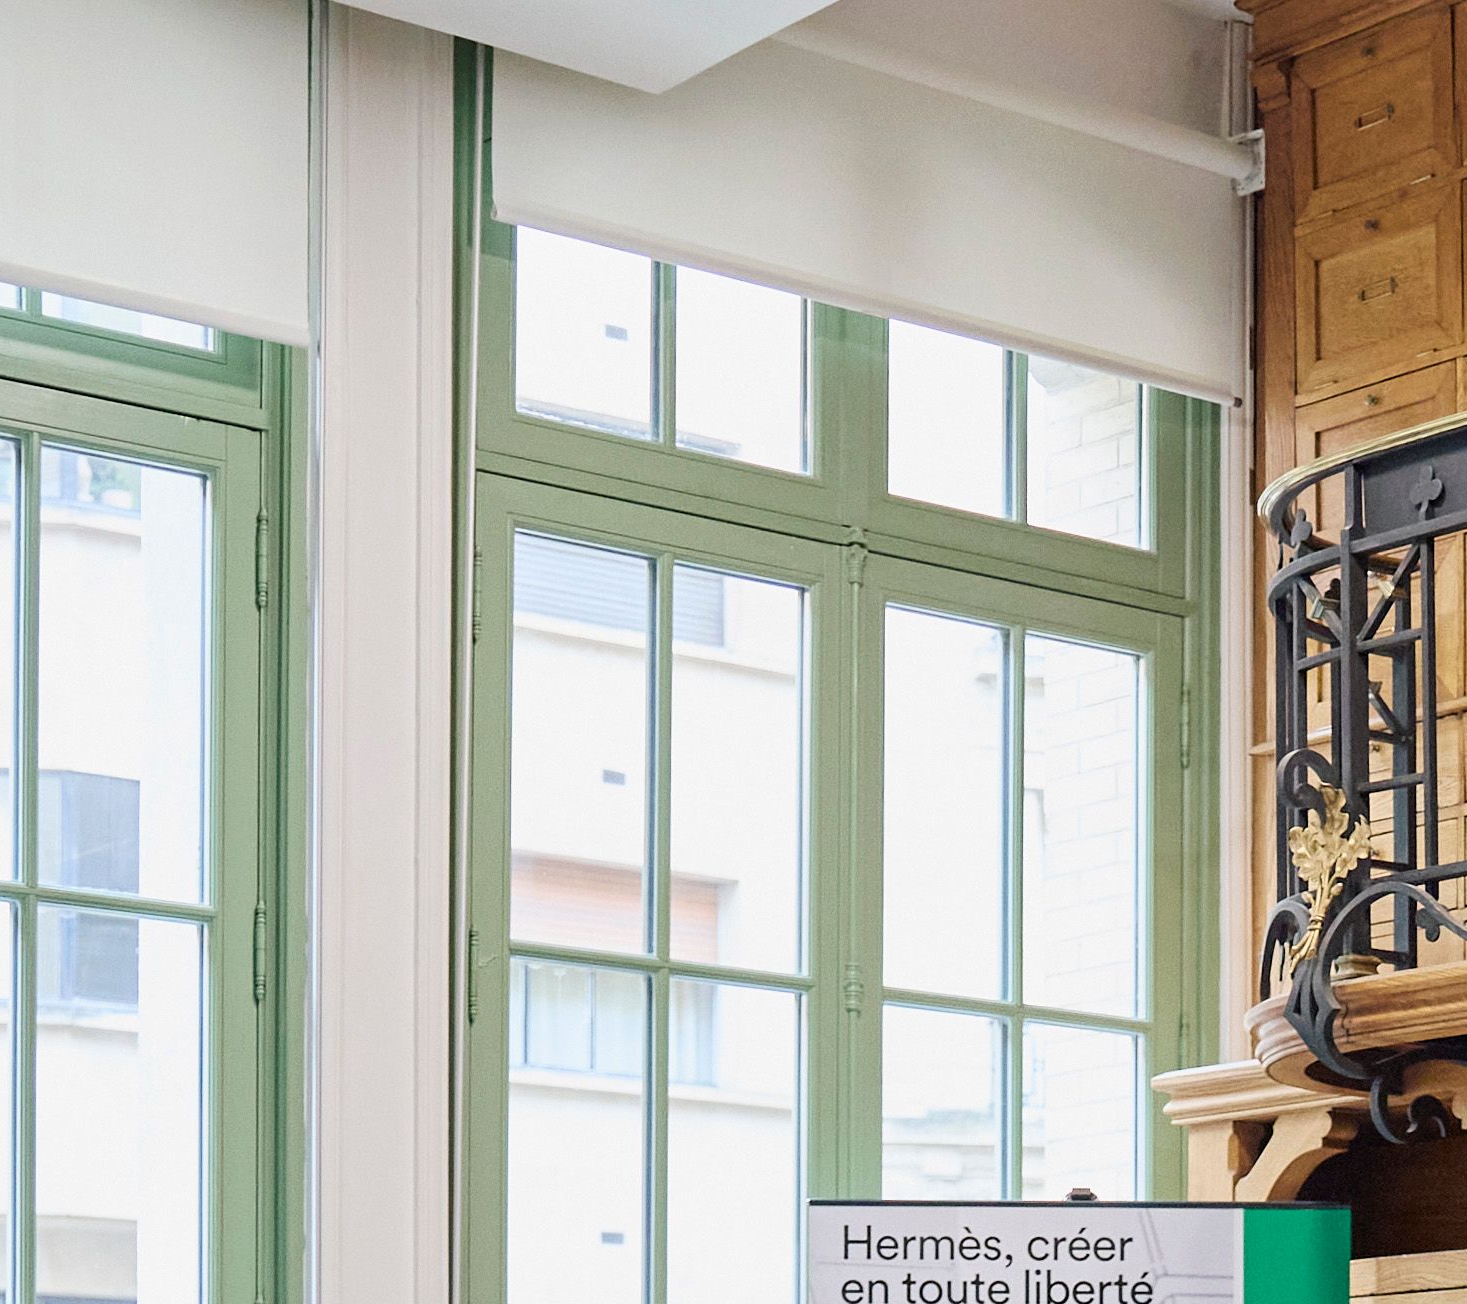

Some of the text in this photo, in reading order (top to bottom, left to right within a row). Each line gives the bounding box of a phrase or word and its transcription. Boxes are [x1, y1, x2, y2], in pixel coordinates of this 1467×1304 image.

[842, 1223, 1134, 1267] Hermès, créer
[840, 1277, 890, 1304] en
